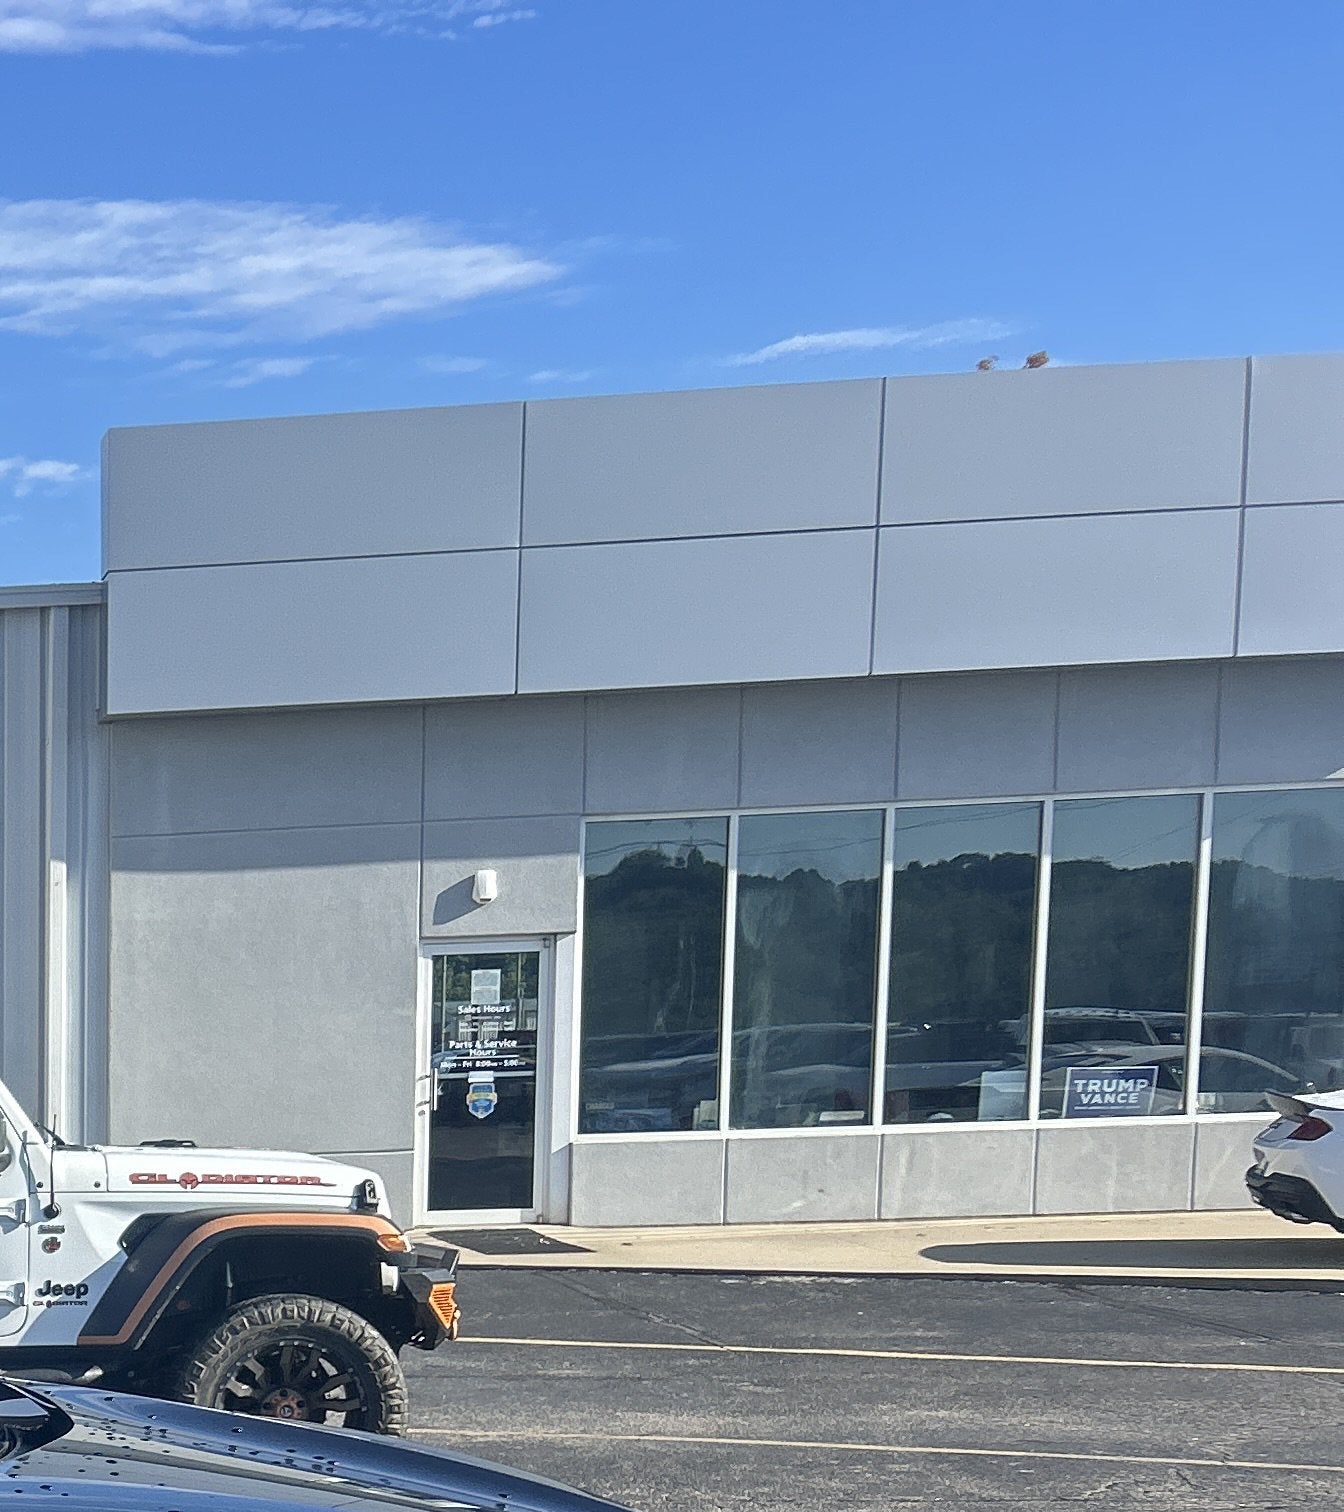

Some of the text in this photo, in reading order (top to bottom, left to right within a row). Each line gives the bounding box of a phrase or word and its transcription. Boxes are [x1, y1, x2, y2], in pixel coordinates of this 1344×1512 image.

[457, 1004, 511, 1014] Sales Hours
[449, 1040, 473, 1049] Parts
[483, 1038, 518, 1049] Service
[469, 1049, 497, 1057] Hours
[1074, 1079, 1149, 1092] TRUMP
[1080, 1093, 1139, 1104] VANCE
[35, 1280, 89, 1299] Jeep
